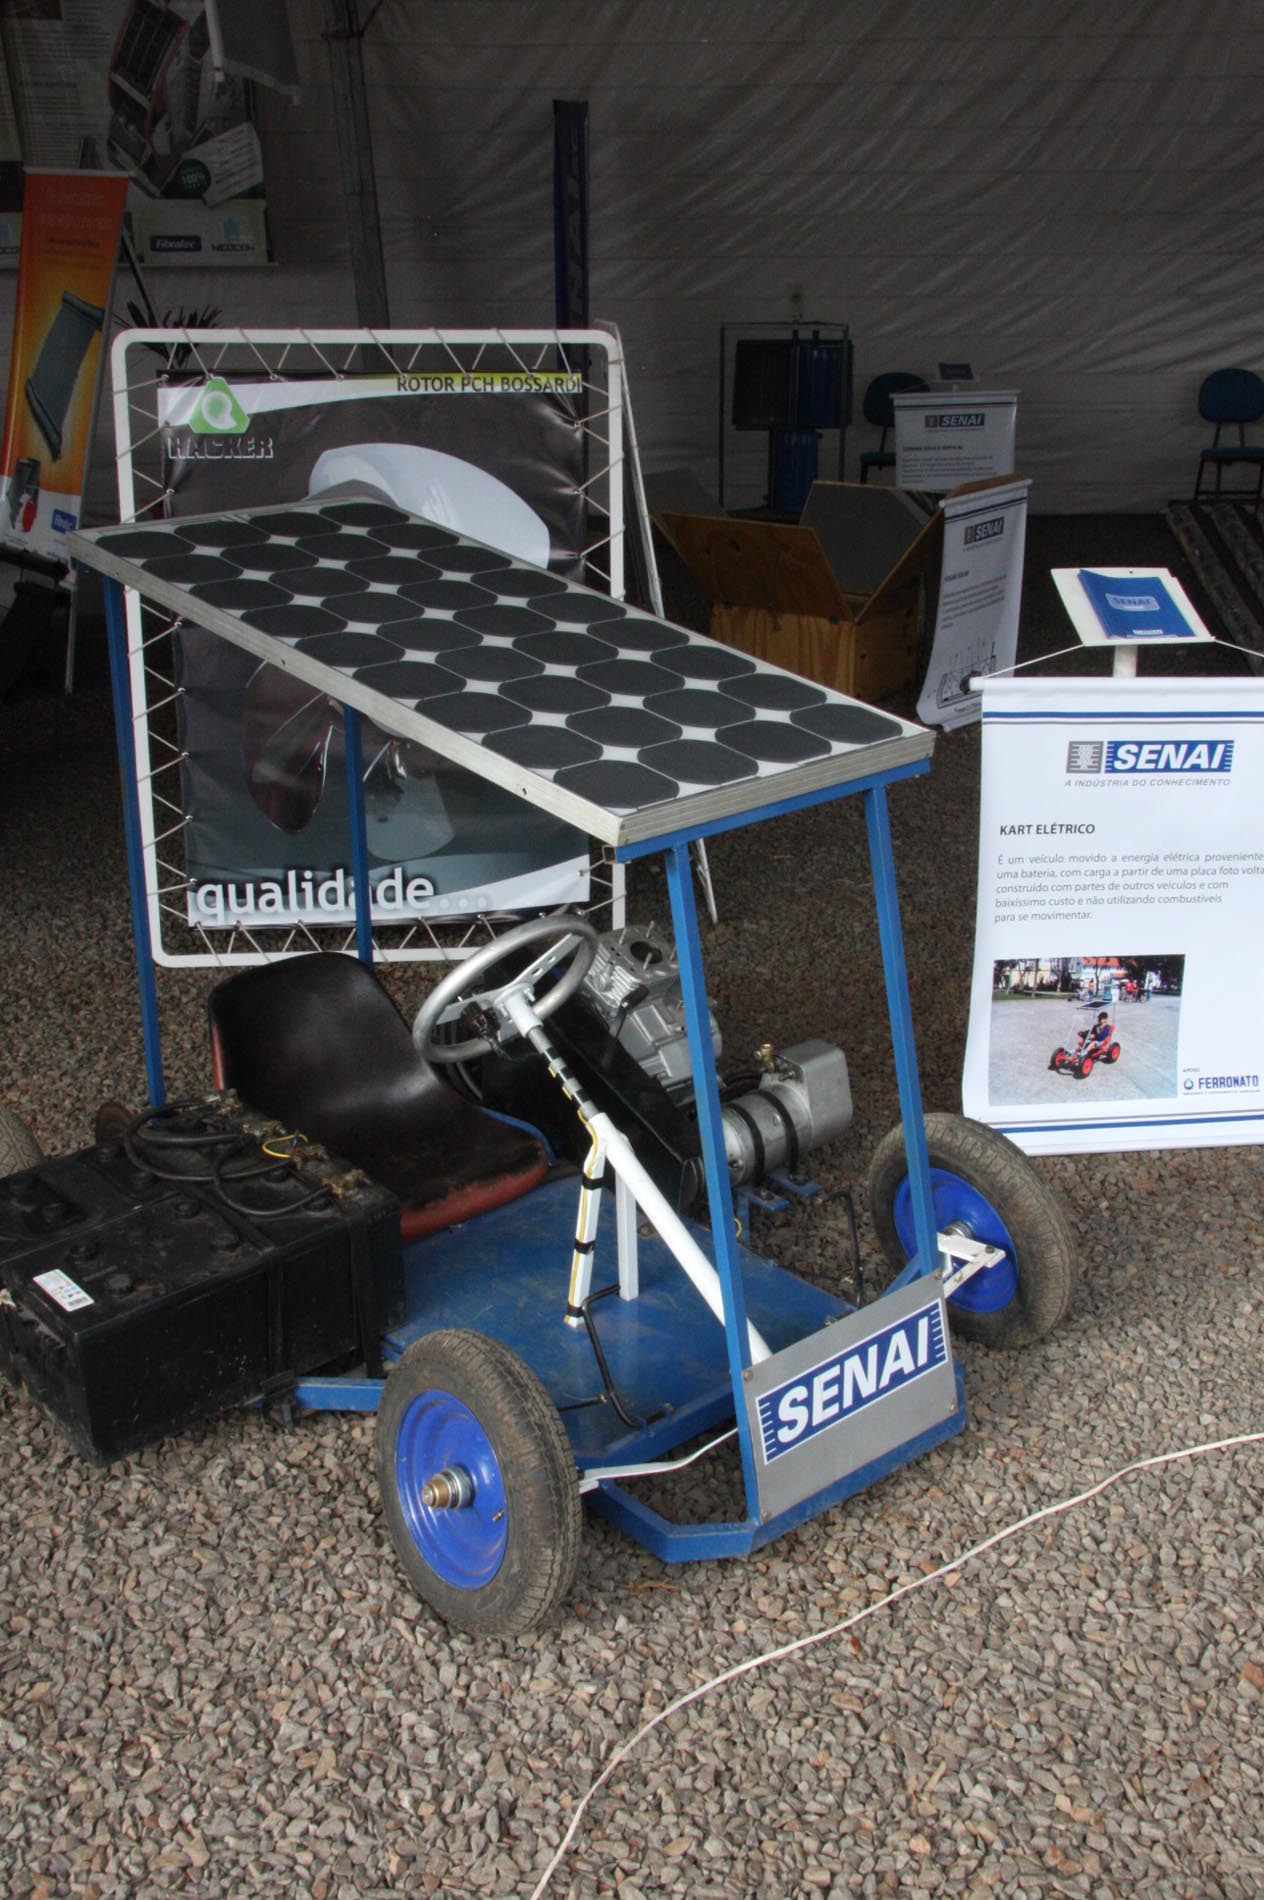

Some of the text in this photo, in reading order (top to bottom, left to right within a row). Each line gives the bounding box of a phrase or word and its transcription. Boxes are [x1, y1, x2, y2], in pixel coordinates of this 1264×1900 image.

[397, 376, 580, 392] ROTOR PCH BOSSARDI
[941, 414, 982, 426] SENAI
[974, 518, 1003, 540] SENAI
[1112, 743, 1226, 771] SENAI
[1064, 777, 1231, 788] A INDÚSTRIA DO CONHECIMENTO
[1000, 822, 1096, 836] KART ELÉTRICO
[998, 854, 1004, 865] É
[1029, 854, 1064, 864] veículo
[1069, 854, 1107, 863] movido
[1121, 853, 1159, 864] energia
[1163, 851, 1200, 862] elétrica
[1204, 852, 1264, 863] proveniente
[997, 871, 1019, 879] uma
[1020, 868, 1057, 879] bateria,
[1083, 870, 1111, 879] carga
[1121, 867, 1149, 878] partir
[1150, 867, 1164, 876] de
[1190, 867, 1217, 877] placa
[1219, 866, 1240, 876] foto
[1051, 884, 1072, 892] com
[1074, 882, 1105, 892] partes
[1107, 882, 1121, 890] de
[1122, 882, 1154, 890] outros
[1157, 881, 1197, 890] veículos
[1048, 897, 1075, 906] custo
[1086, 896, 1105, 905] não
[1107, 895, 1156, 904] utilizando
[994, 911, 1093, 923] para se movimentar.
[1198, 1075, 1259, 1089] FERRONATO
[777, 1316, 928, 1444] SENAI
